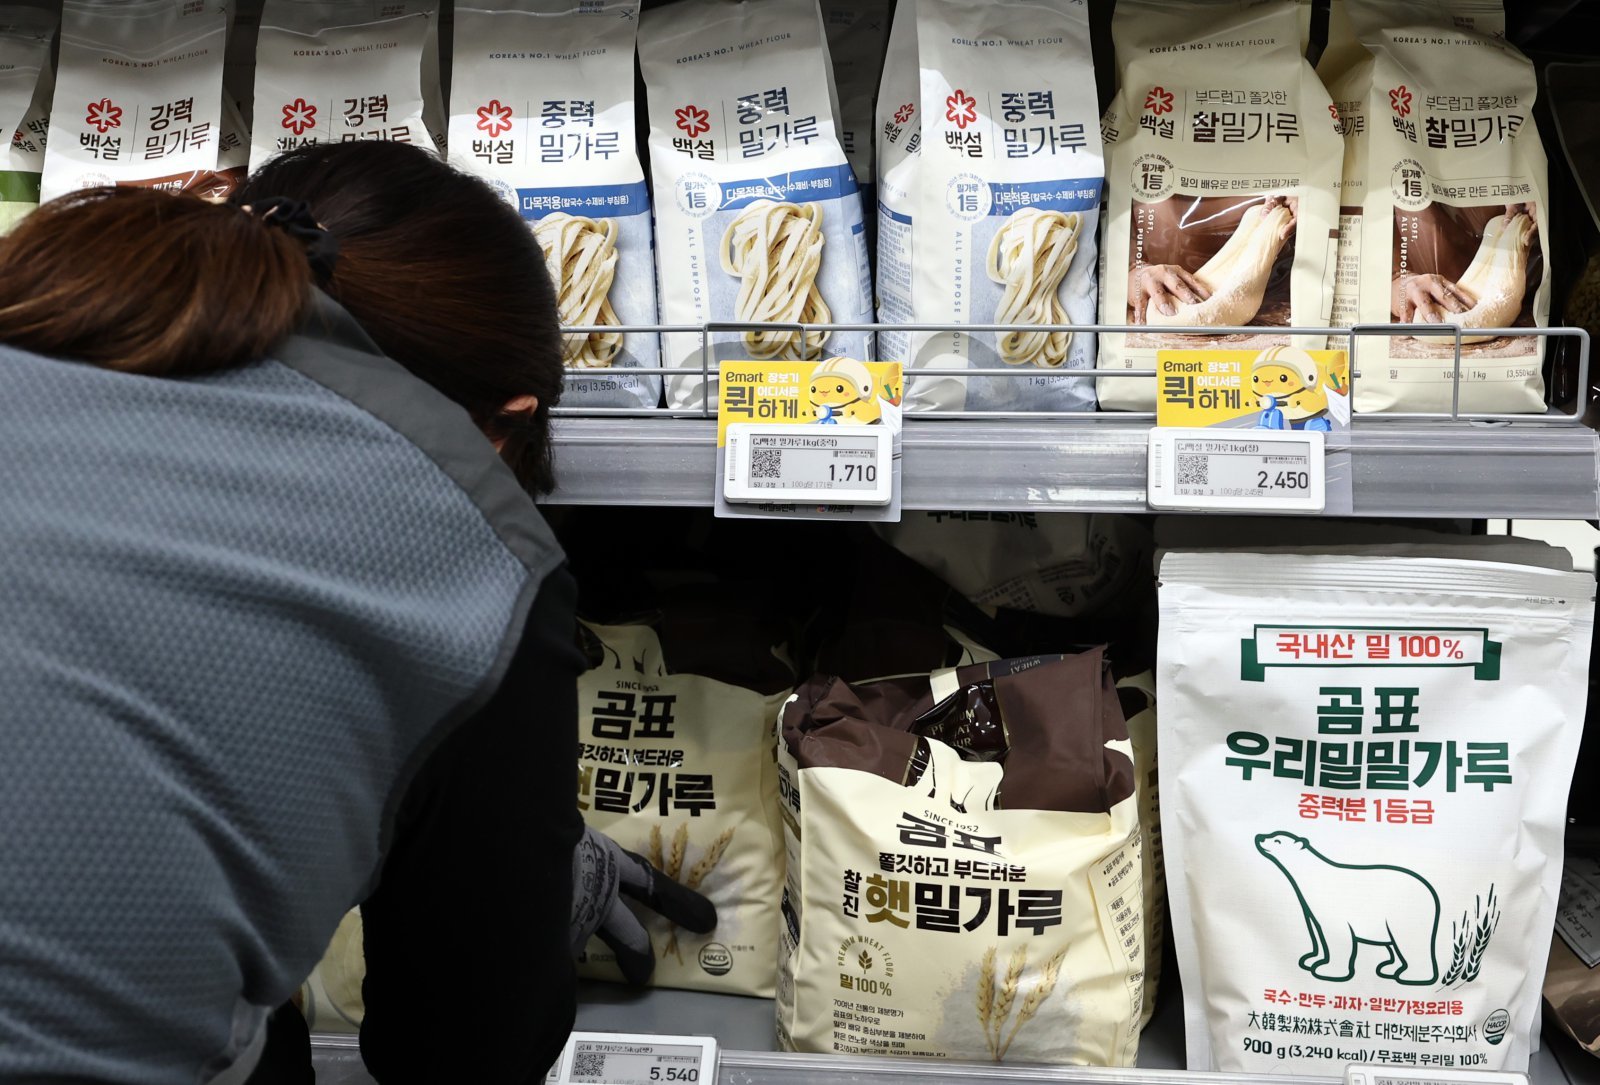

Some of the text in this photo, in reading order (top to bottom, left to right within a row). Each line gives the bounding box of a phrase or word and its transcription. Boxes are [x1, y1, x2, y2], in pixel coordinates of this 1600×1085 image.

[554, 52, 580, 60] WHEAT
[583, 48, 607, 56] FLOUR
[676, 33, 791, 65] KOREA'S NO.1 WHEAT FLOUR
[1149, 45, 1186, 54] KOREA'S
[1216, 40, 1245, 48] WHEAT
[1249, 38, 1275, 46] FLOUR
[343, 94, 389, 127] 강력
[736, 87, 790, 126] 중력
[1001, 90, 1056, 122] 중력
[1195, 90, 1288, 106] 부드럽고 쫄깃한
[1425, 95, 1517, 111] 부드럽고 쫄깃한
[150, 97, 194, 131] 강력
[541, 100, 595, 128] 중력
[1140, 114, 1174, 140] 백설
[1192, 111, 1300, 143] 찰밀가루
[144, 122, 211, 160] 밀가루
[740, 116, 820, 158] 밀가루
[1004, 124, 1087, 158] 밀가루
[1392, 115, 1418, 143] 백설
[1425, 114, 1524, 149] 찰밀가루
[80, 132, 121, 161] 백설
[472, 138, 514, 165] 백설
[539, 132, 620, 164] 밀가루
[672, 137, 714, 161] 백설
[945, 131, 983, 158] 백설
[1142, 163, 1165, 172] 밀가루
[1142, 172, 1163, 190] 1등
[1402, 169, 1421, 179] 밀가루
[957, 184, 978, 192] 밀가루
[1180, 176, 1299, 190] 밀의 배유로 만든 고급밀가루
[1402, 179, 1422, 197] 1등
[1469, 186, 1488, 198] 만든
[686, 192, 707, 208] 1등
[957, 194, 978, 211] 1등
[1147, 209, 1155, 233] SOFT,
[690, 255, 702, 308] PURPOSE
[954, 259, 962, 313] PURPOSE
[726, 371, 799, 383] emart 장보기
[1163, 361, 1240, 373] emart 장보기
[757, 386, 799, 397] 어디서든
[1197, 376, 1240, 387] 어디서든
[829, 464, 876, 482] 1,710
[1258, 471, 1308, 489] 2,450
[1276, 633, 1464, 660] 국내산 밀 100%
[592, 691, 677, 740] 곰표
[1317, 687, 1420, 735] 곰표
[633, 748, 684, 768] 부드러운
[1225, 731, 1512, 793] 우리밀밀가루
[924, 809, 979, 833] SINCE 1952
[1298, 793, 1434, 824] 중력분 1등급
[879, 852, 1026, 882] 쫄깃하고 부드러운
[843, 869, 862, 918] 찰진
[865, 873, 1063, 936] 햇밀가루
[857, 935, 884, 951] WHEAT
[882, 952, 894, 978] FLOUR
[833, 1010, 880, 1025] 곰표의 노하우로
[1248, 1010, 1477, 1043] 大韓製粉株式會社 대한제분주식회사
[1243, 1037, 1272, 1055] 900
[1277, 1046, 1285, 1059] g
[1288, 1045, 1333, 1059] (3,240
[1337, 1046, 1367, 1062] kcal)
[1377, 1050, 1417, 1065] 무표백
[1420, 1053, 1454, 1066] 우리밀
[1459, 1052, 1488, 1066] 100%
[650, 1067, 698, 1082] 5,540
